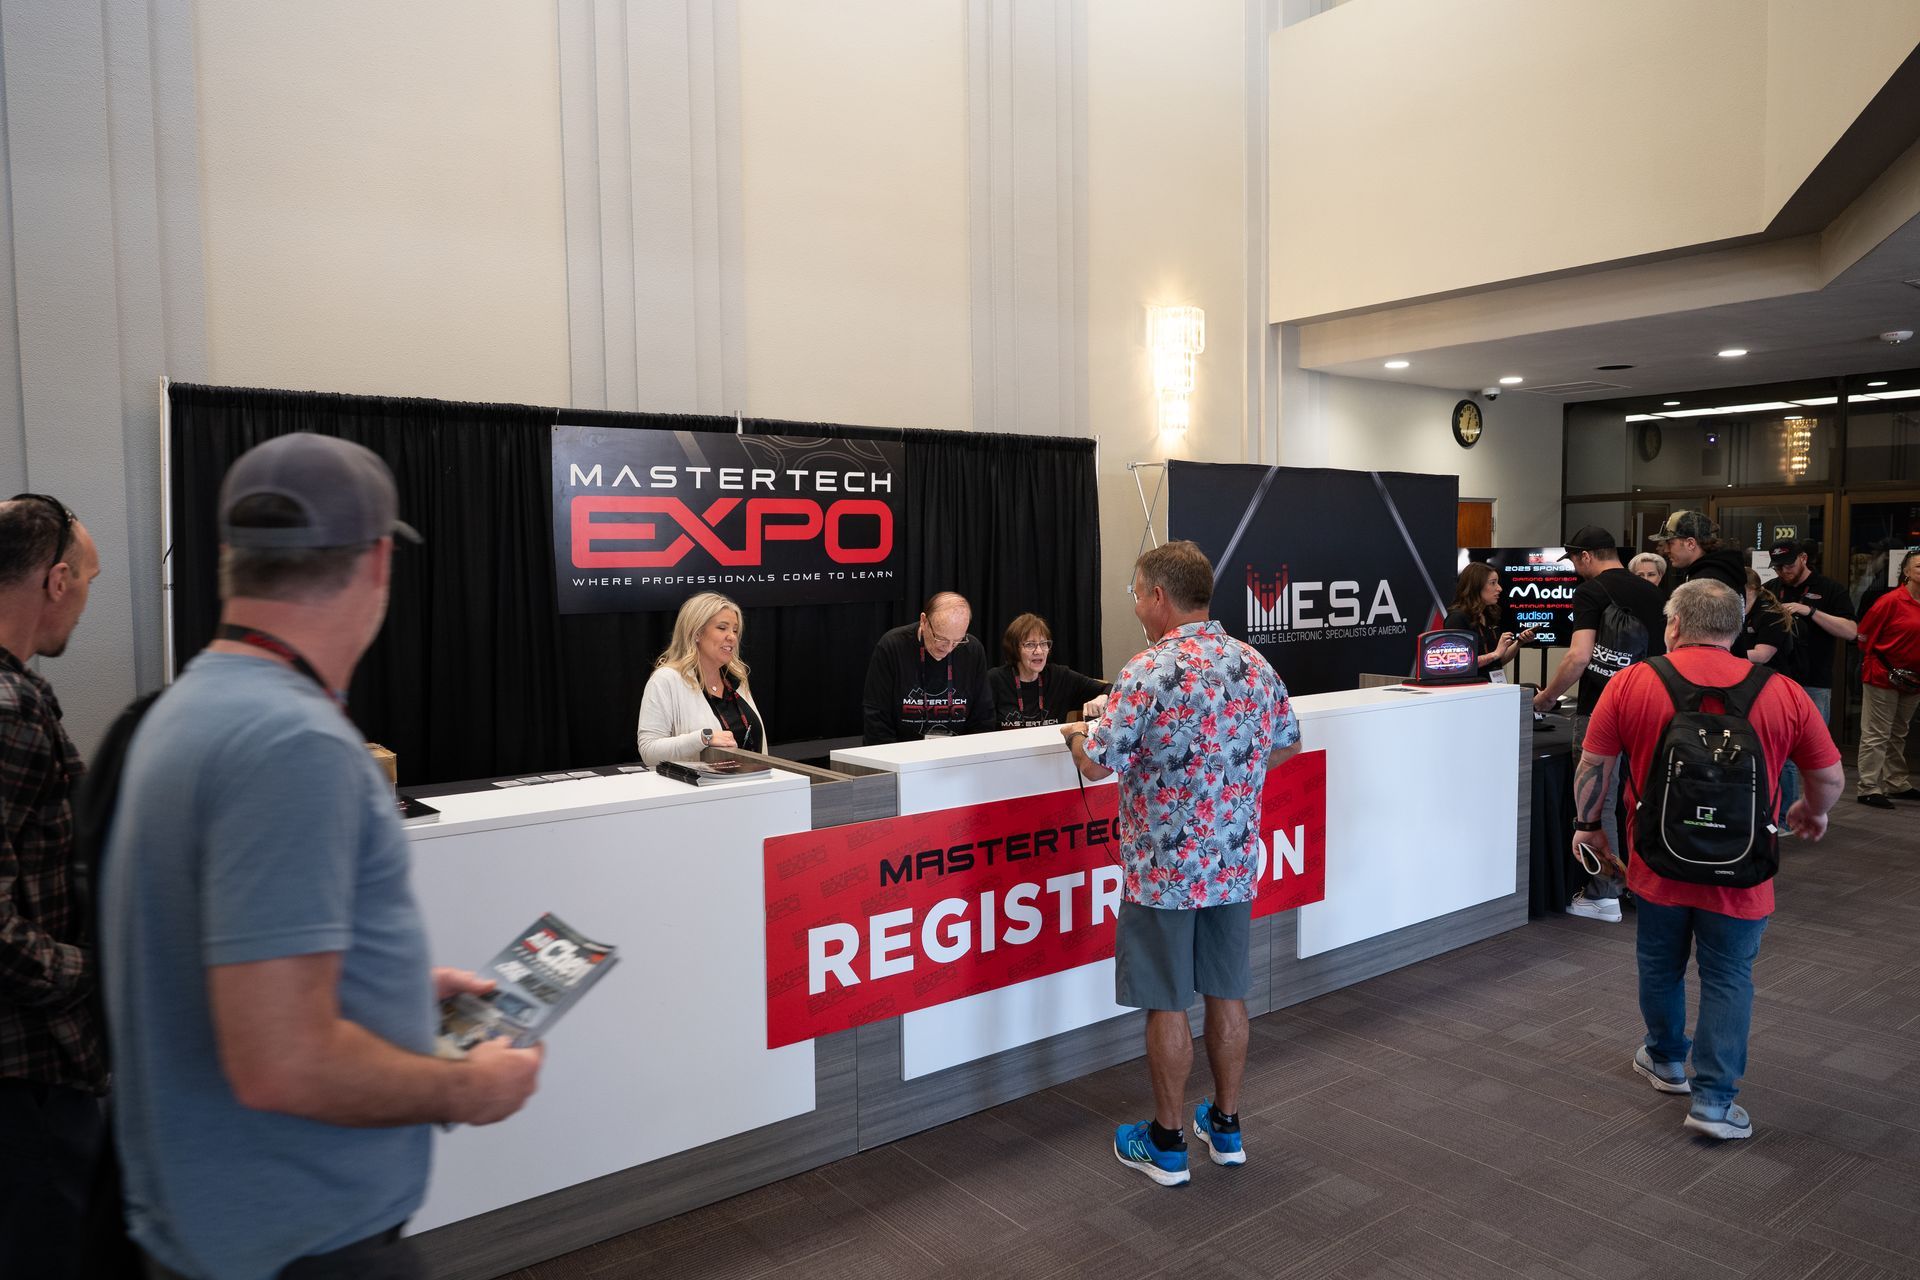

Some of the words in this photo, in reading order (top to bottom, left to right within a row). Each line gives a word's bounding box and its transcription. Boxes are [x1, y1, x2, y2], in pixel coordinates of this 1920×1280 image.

[570, 463, 892, 493] MASTERTECH
[570, 495, 894, 569] EXPO
[572, 577, 633, 586] WHERE
[642, 573, 776, 585] PROFESSIONALS
[783, 573, 821, 582] COME
[828, 571, 846, 580] TO
[851, 570, 894, 579] LEARN
[1508, 583, 1576, 599] Modu
[1516, 611, 1554, 620] audison
[1248, 635, 1277, 645] MOBILE
[1278, 631, 1323, 643] ELECTRONIC
[1325, 627, 1367, 640] SPECIALISTS
[1367, 626, 1377, 636] OF
[1378, 625, 1407, 636] AMERICA
[1426, 647, 1469, 655] MASTERTECH
[1595, 643, 1633, 658] STERTECH
[1427, 653, 1469, 665] EXPO
[880, 816, 1121, 888] MASTERTE
